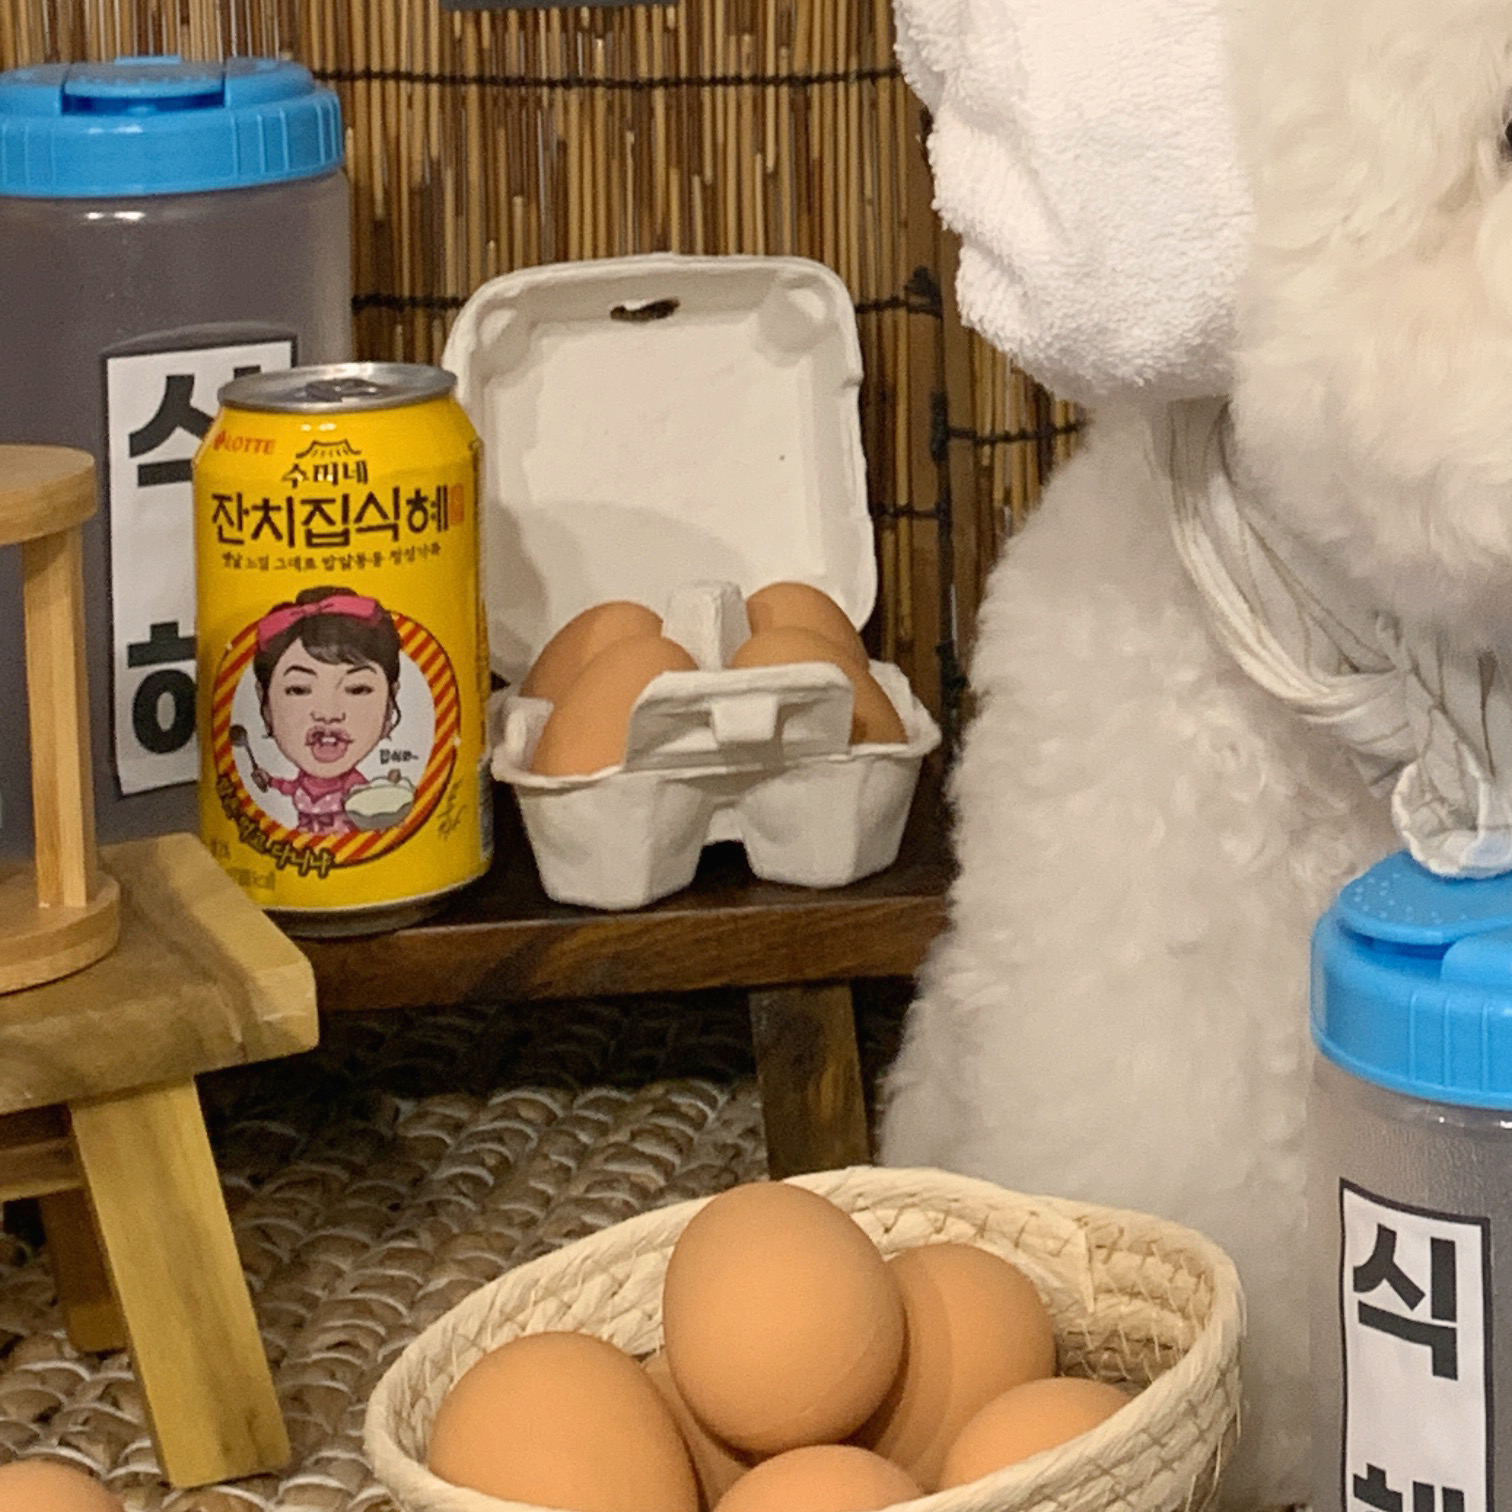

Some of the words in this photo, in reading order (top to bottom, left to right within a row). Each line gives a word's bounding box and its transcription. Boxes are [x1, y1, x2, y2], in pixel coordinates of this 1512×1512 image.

[222, 434, 277, 456] LOTTE
[282, 460, 369, 489] 수미네
[211, 484, 449, 549] 잔치집식혜
